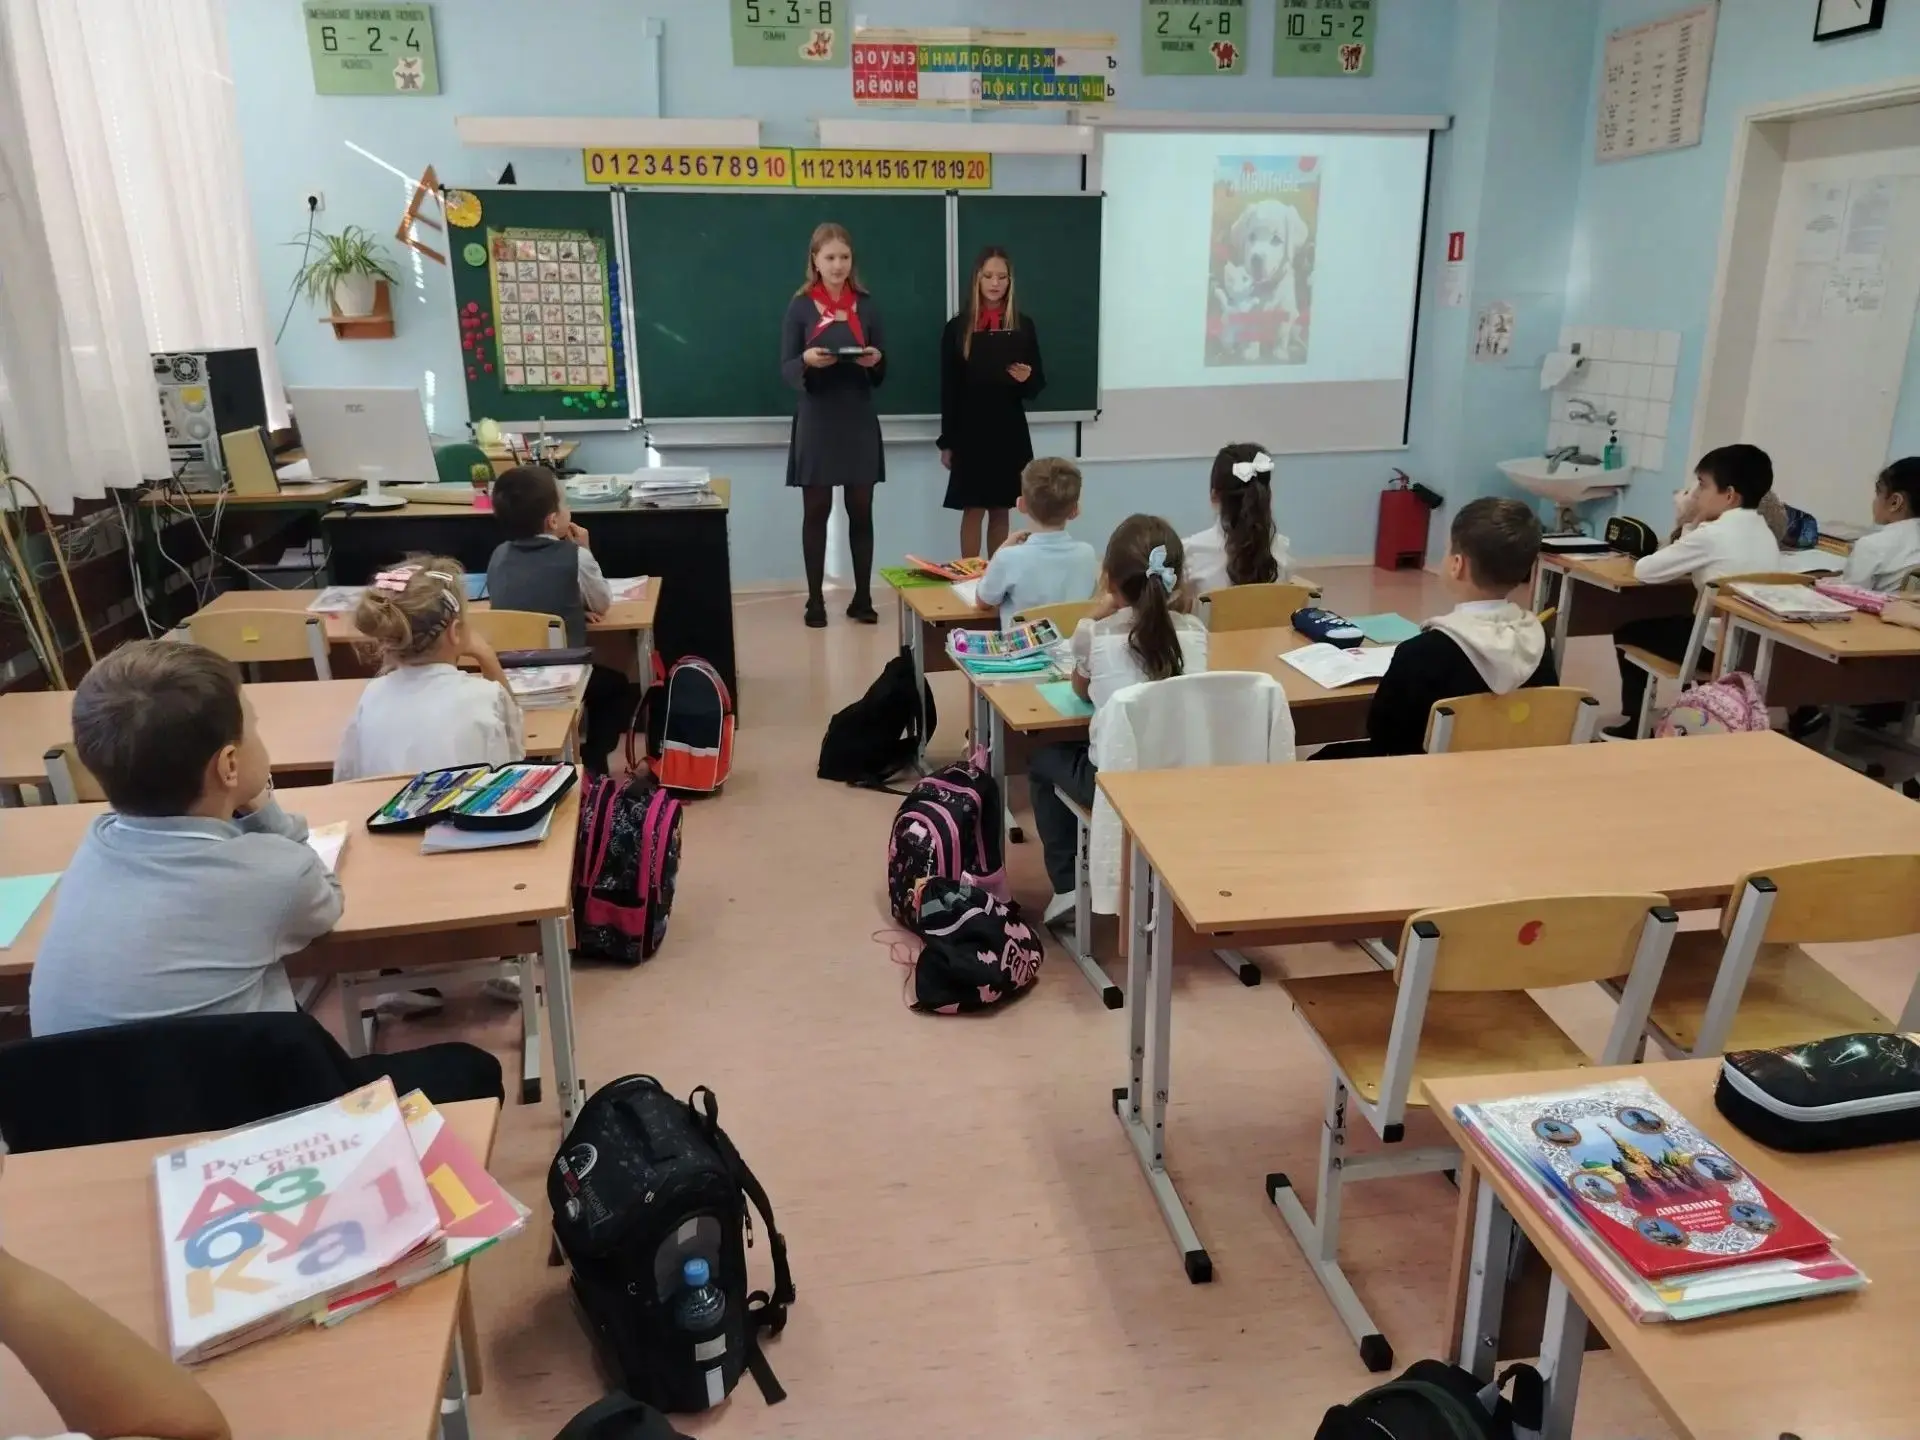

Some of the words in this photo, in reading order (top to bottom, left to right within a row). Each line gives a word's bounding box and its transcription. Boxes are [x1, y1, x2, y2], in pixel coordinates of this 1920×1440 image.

[746, 0, 760, 23] 5
[787, 0, 800, 23] 3
[819, 0, 832, 24] 8
[1157, 11, 1169, 34] 2
[1188, 12, 1201, 35] 4
[1219, 12, 1231, 35] 8
[1287, 14, 1305, 36] 10
[1320, 14, 1333, 37] 5
[1352, 15, 1365, 38] 2
[321, 26, 338, 51] 6
[367, 27, 383, 52] 2
[406, 27, 420, 52] 4
[592, 153, 604, 174] 0
[610, 154, 619, 174] 1
[627, 154, 639, 175] 2
[645, 154, 656, 175] 3
[661, 155, 674, 176] 4
[679, 155, 691, 176] 5
[696, 155, 708, 176] 6
[712, 156, 724, 177] 7
[730, 156, 741, 177] 8
[746, 156, 758, 177] 9
[764, 156, 785, 178] 10
[801, 159, 814, 178] 11
[819, 159, 834, 179] 12
[838, 159, 854, 179] 13
[856, 159, 872, 179] 14
[876, 159, 891, 179] 15
[894, 159, 909, 179] 16
[913, 160, 928, 179] 17
[931, 160, 946, 179] 18
[950, 160, 965, 179] 19
[967, 160, 985, 180] 20
[202, 1132, 331, 1180] Русский
[361, 1166, 420, 1224] 1
[426, 1162, 494, 1229] 1
[1656, 1199, 1723, 1217] ДНЕВНИК
